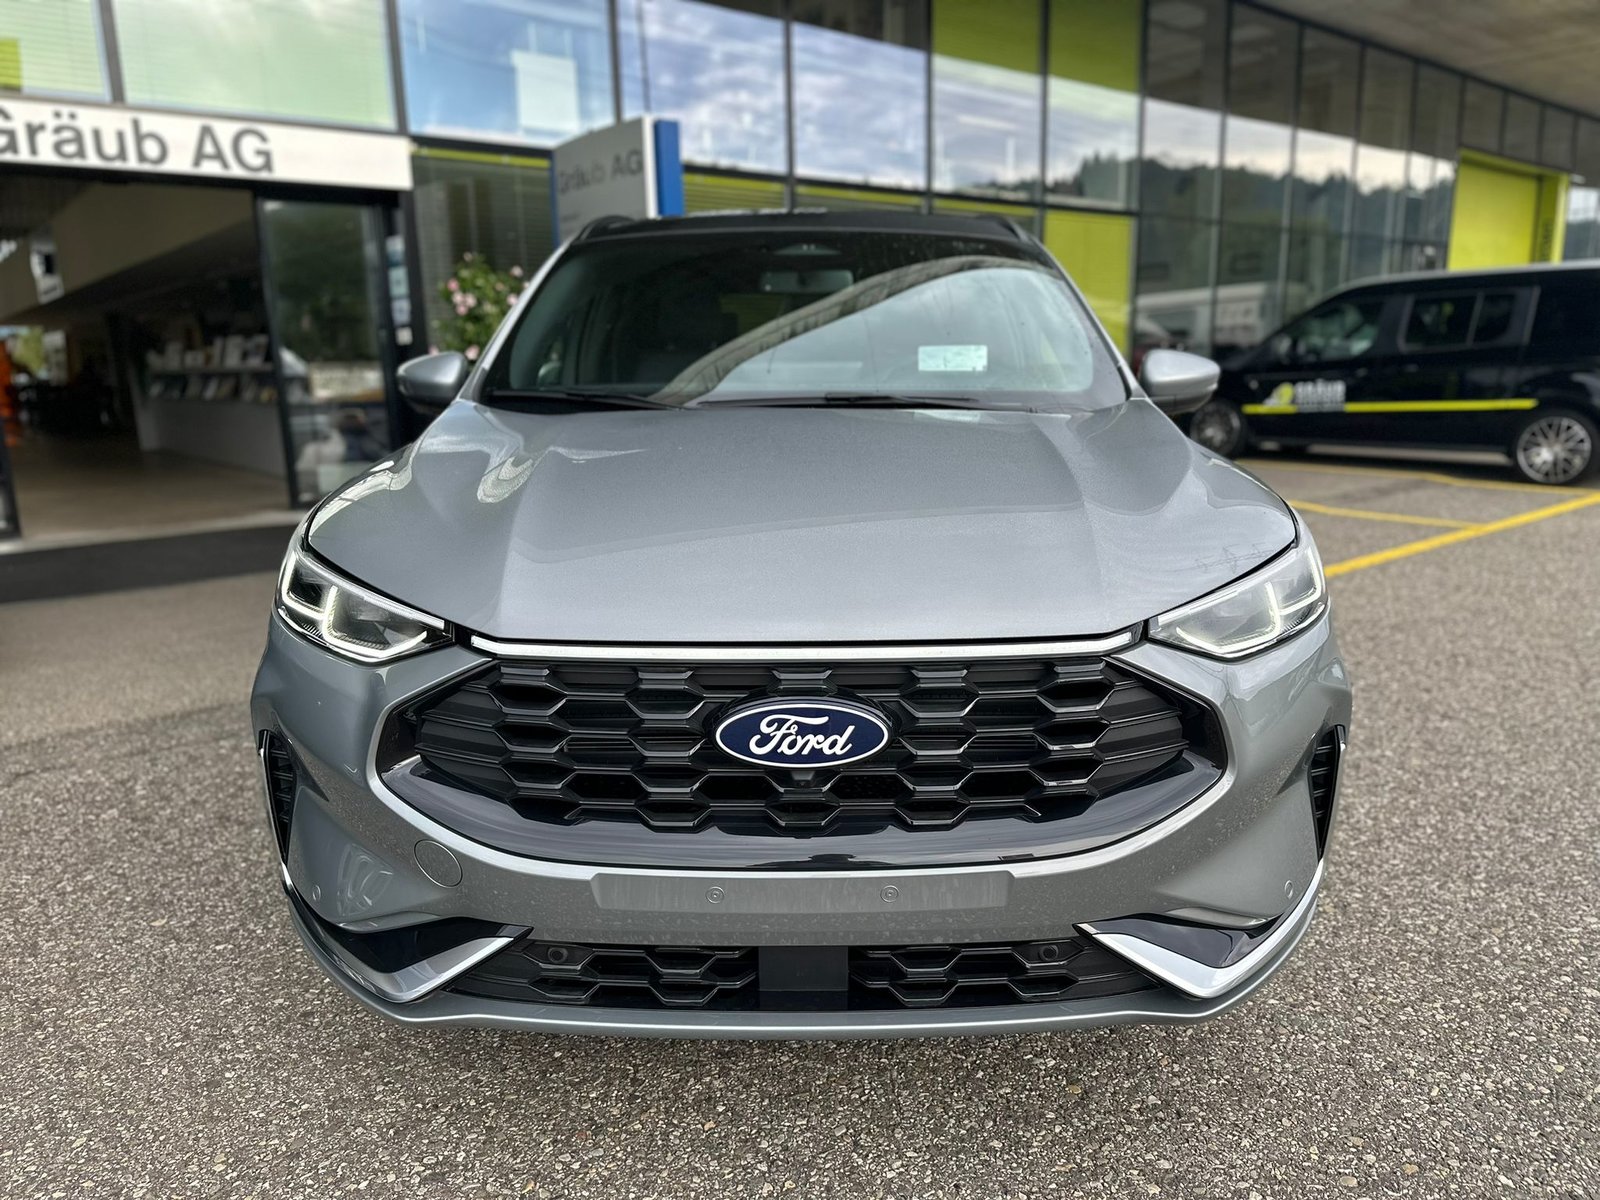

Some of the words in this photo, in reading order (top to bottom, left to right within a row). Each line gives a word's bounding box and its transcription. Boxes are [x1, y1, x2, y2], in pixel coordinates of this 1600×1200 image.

[192, 124, 274, 174] AG
[612, 149, 643, 178] AG
[749, 714, 855, 755] Ford
